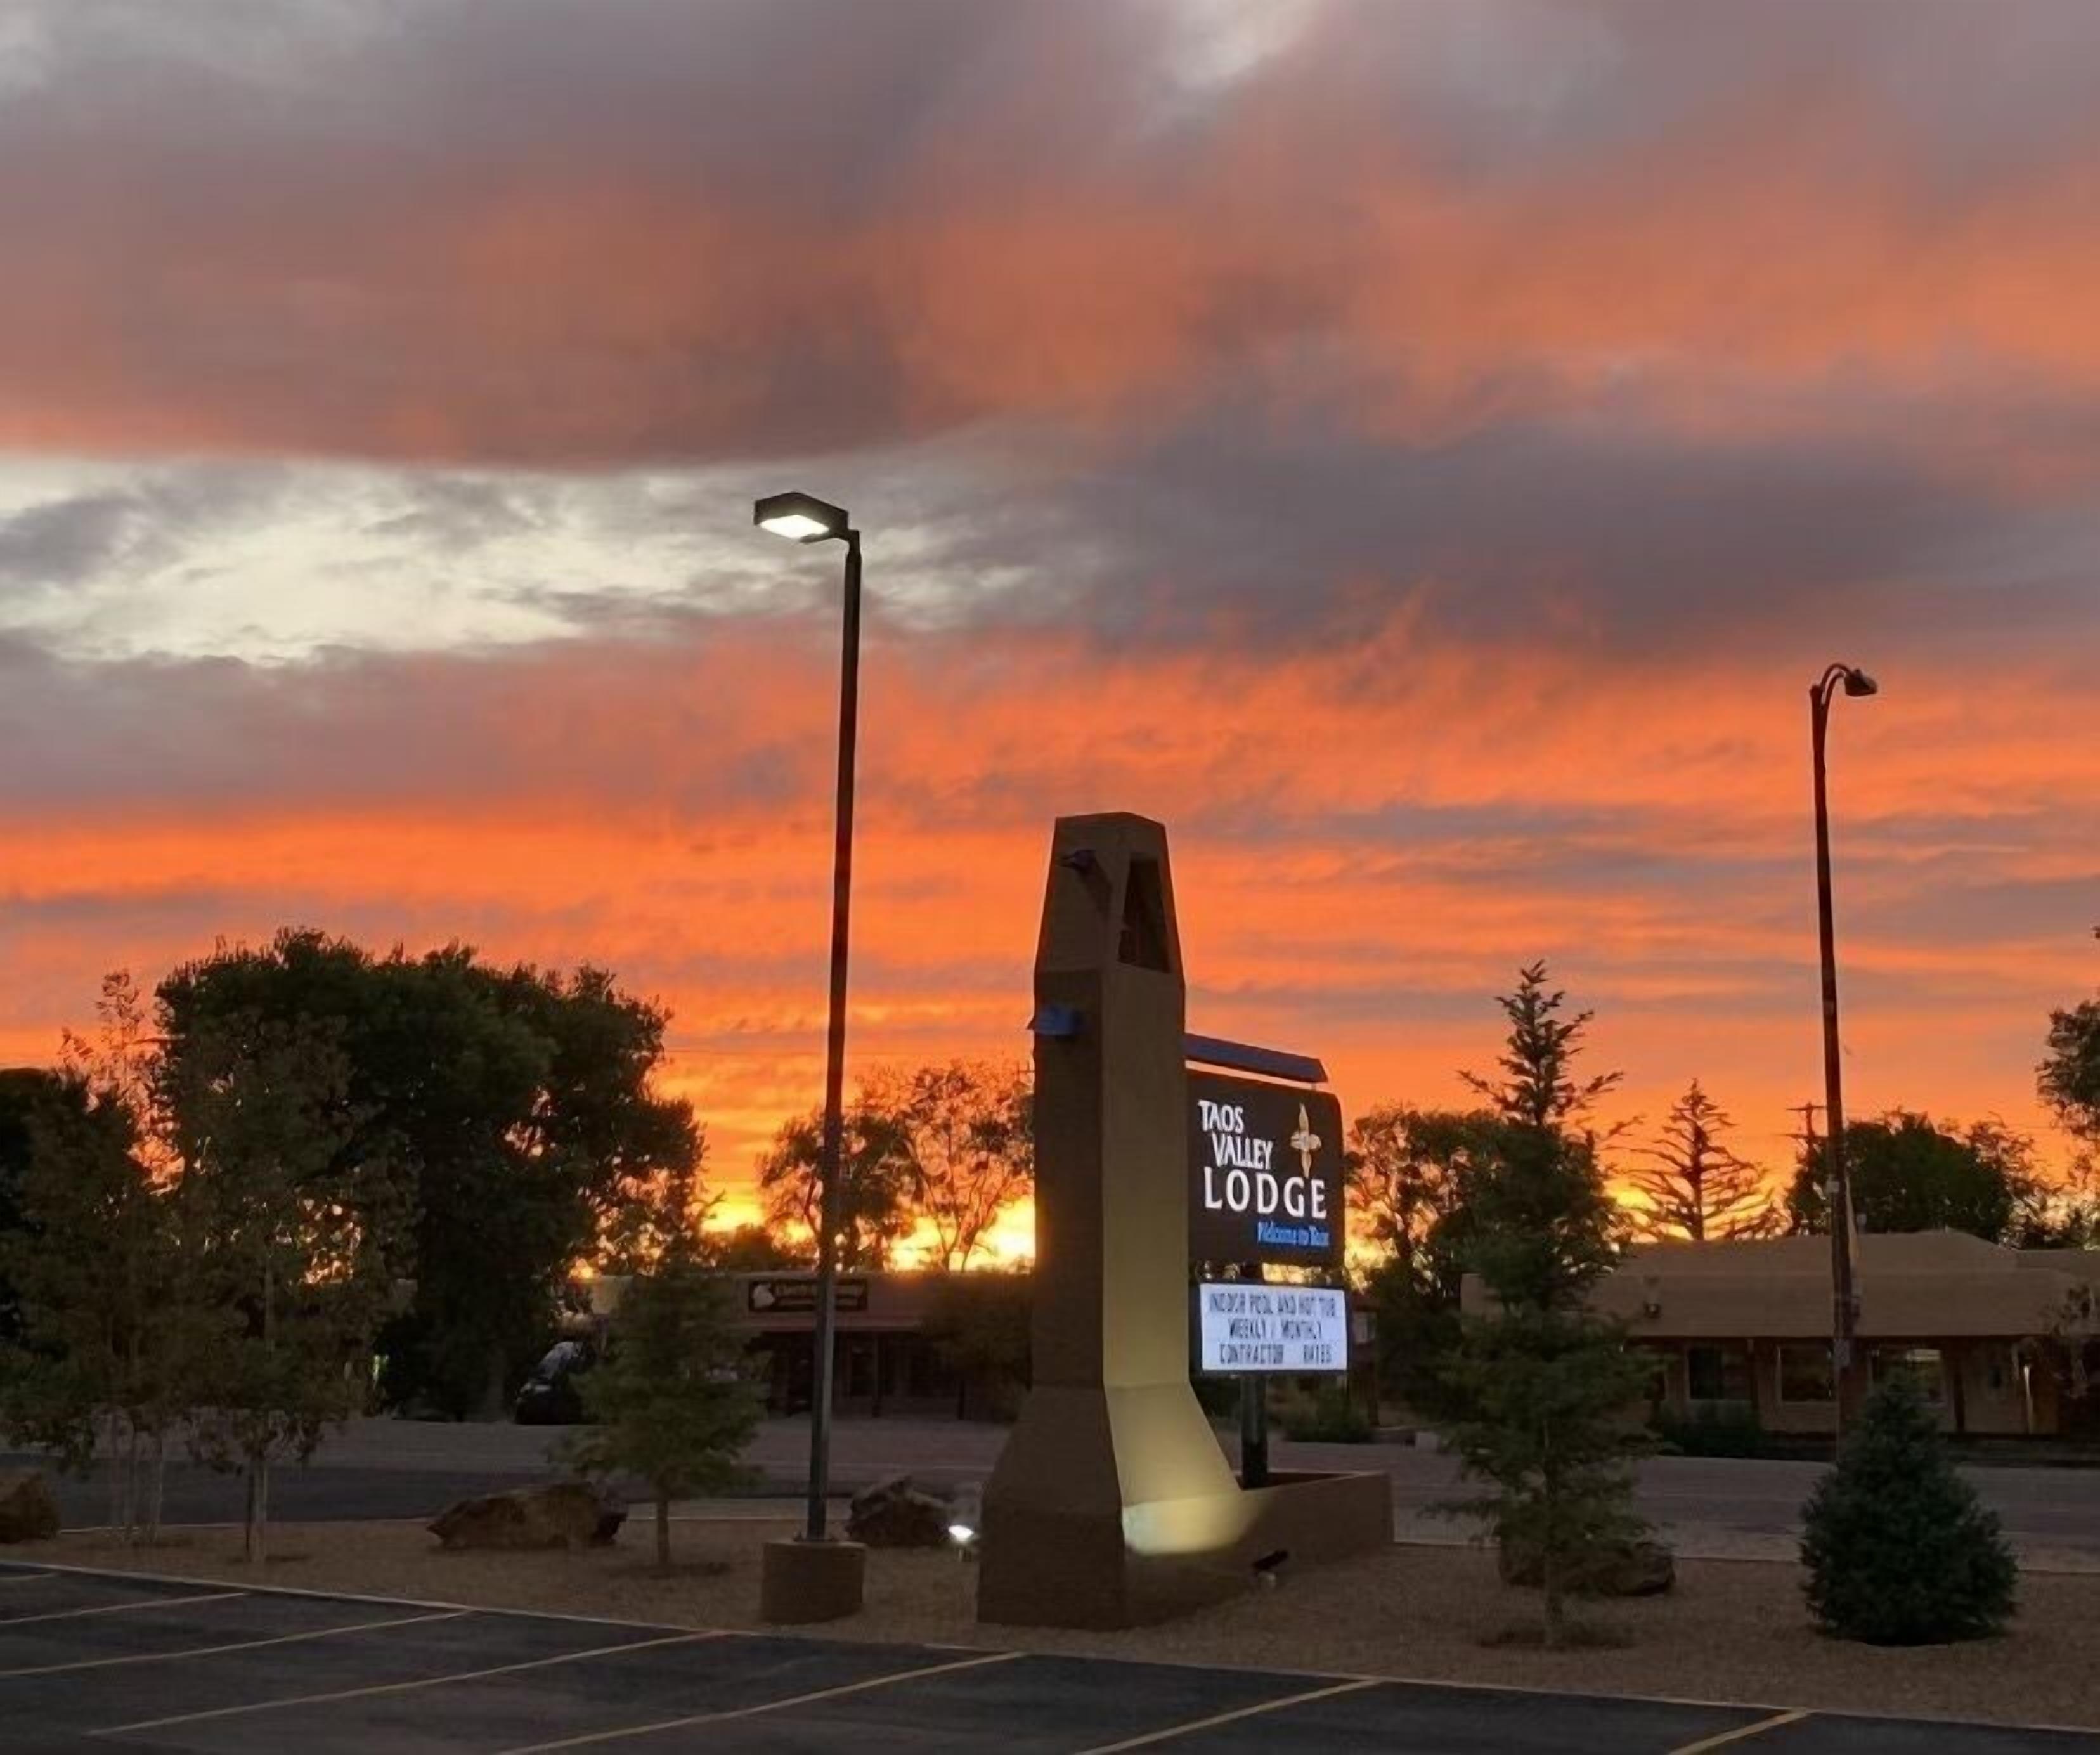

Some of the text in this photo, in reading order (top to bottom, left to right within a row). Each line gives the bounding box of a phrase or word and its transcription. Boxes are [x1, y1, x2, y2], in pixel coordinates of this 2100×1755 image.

[1198, 1099, 1244, 1134] TAOS
[1212, 1131, 1273, 1170] VALLEY
[1204, 1166, 1327, 1219] LODGE
[1250, 1294, 1273, 1314] POOL
[1278, 1295, 1297, 1314] AND
[1228, 1318, 1266, 1339] WEEKLY
[1219, 1344, 1332, 1364] CONTRACTOR RATES
